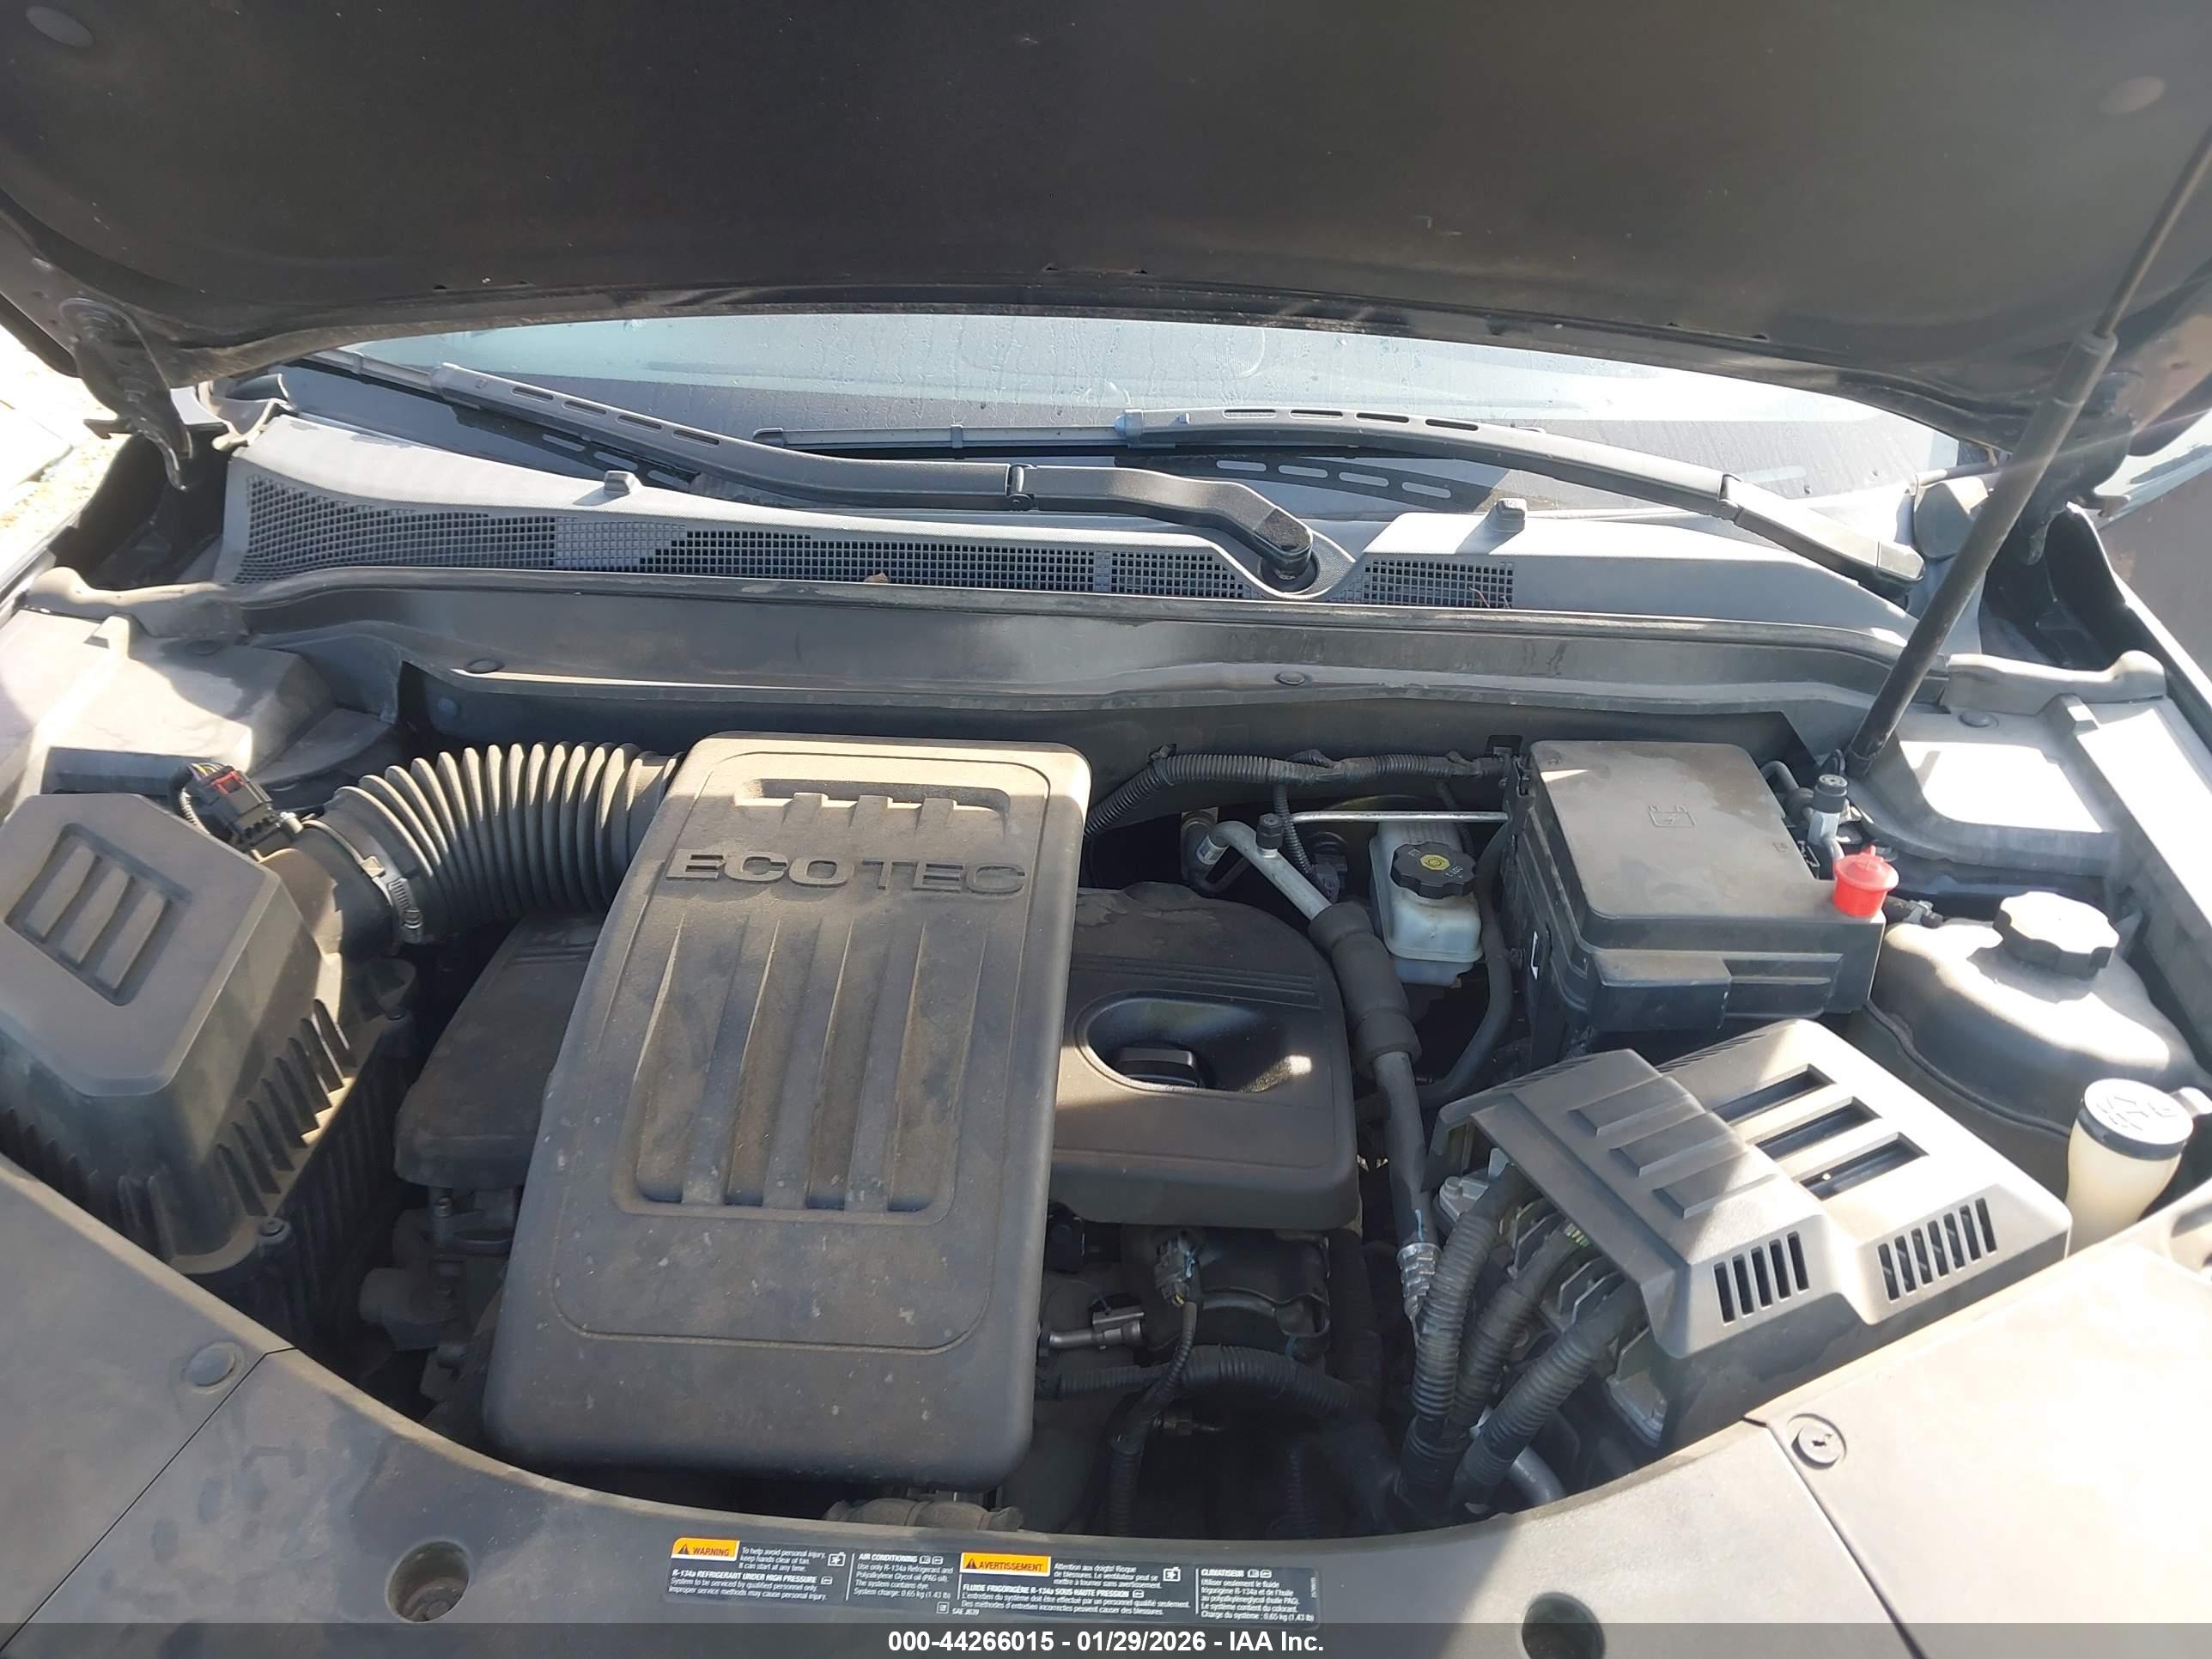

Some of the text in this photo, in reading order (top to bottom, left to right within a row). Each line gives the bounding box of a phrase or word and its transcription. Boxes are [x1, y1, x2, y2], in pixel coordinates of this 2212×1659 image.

[665, 848, 1026, 896] ECOTEC
[692, 1547, 729, 1557] WARNING
[750, 1547, 763, 1556] help
[781, 1549, 807, 1558] personal
[740, 1555, 754, 1564] keep
[872, 1554, 918, 1563] CONDITIONING
[979, 1561, 1043, 1571] AVERTISSEMENT
[696, 1571, 741, 1579] REFRIGERANT
[743, 1572, 764, 1581] UNDER
[783, 1575, 817, 1583] PRESSURE
[671, 1578, 693, 1587] System
[746, 1581, 772, 1590] qualified
[781, 1591, 807, 1600] personal
